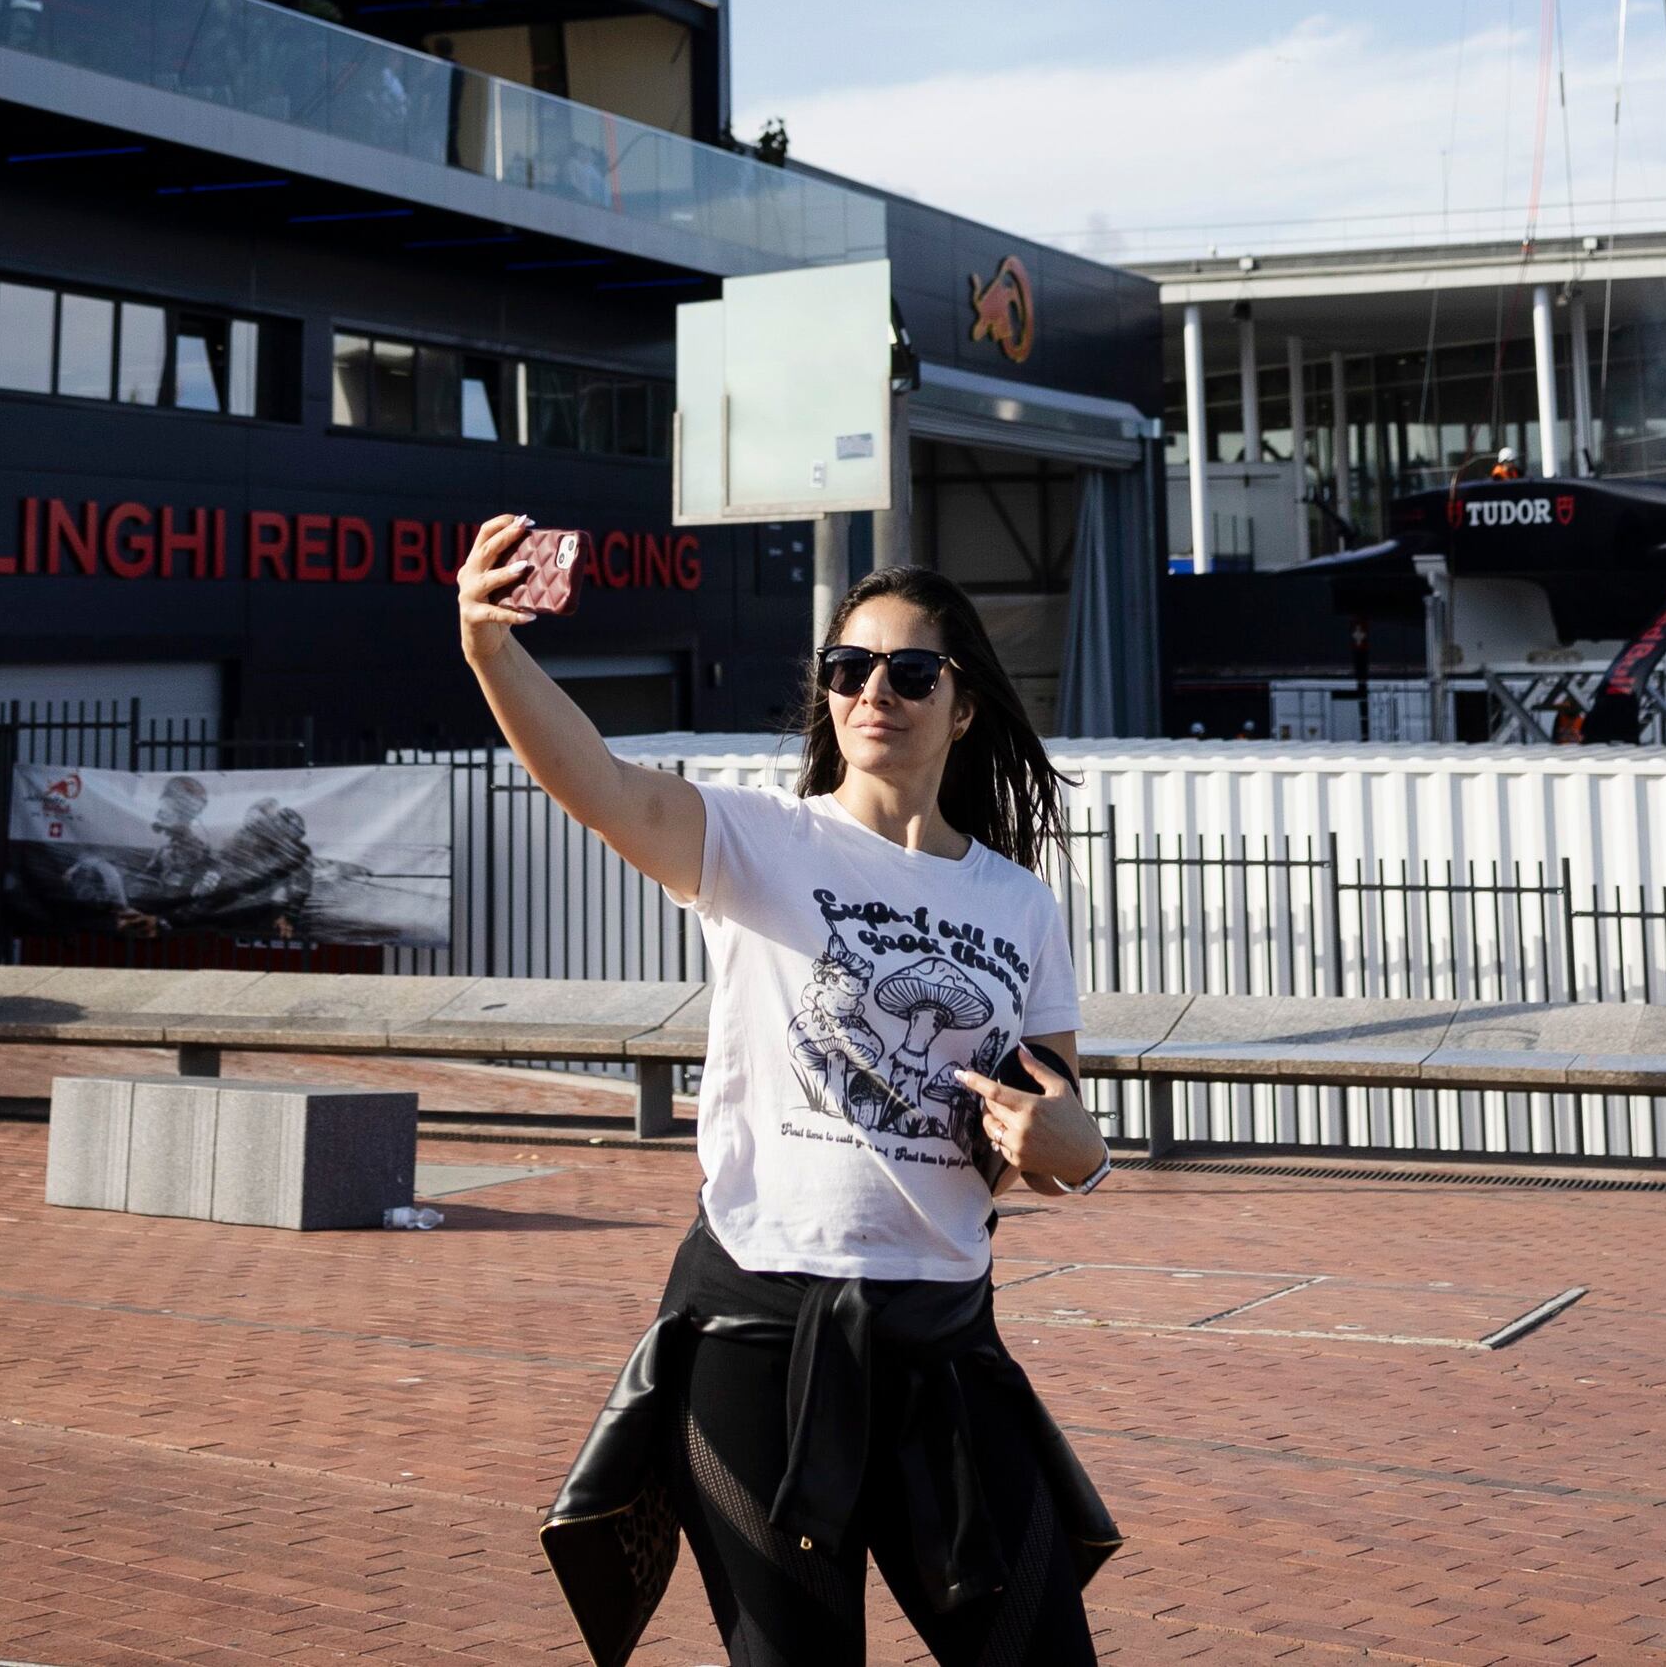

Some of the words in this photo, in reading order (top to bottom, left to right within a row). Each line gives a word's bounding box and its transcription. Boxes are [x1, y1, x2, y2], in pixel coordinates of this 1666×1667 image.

[1466, 498, 1552, 526] TUDOR
[249, 510, 375, 582] RED
[391, 518, 480, 584] BU
[579, 530, 703, 591] ACING
[1605, 641, 1657, 695] Bull
[993, 936, 1030, 983] the
